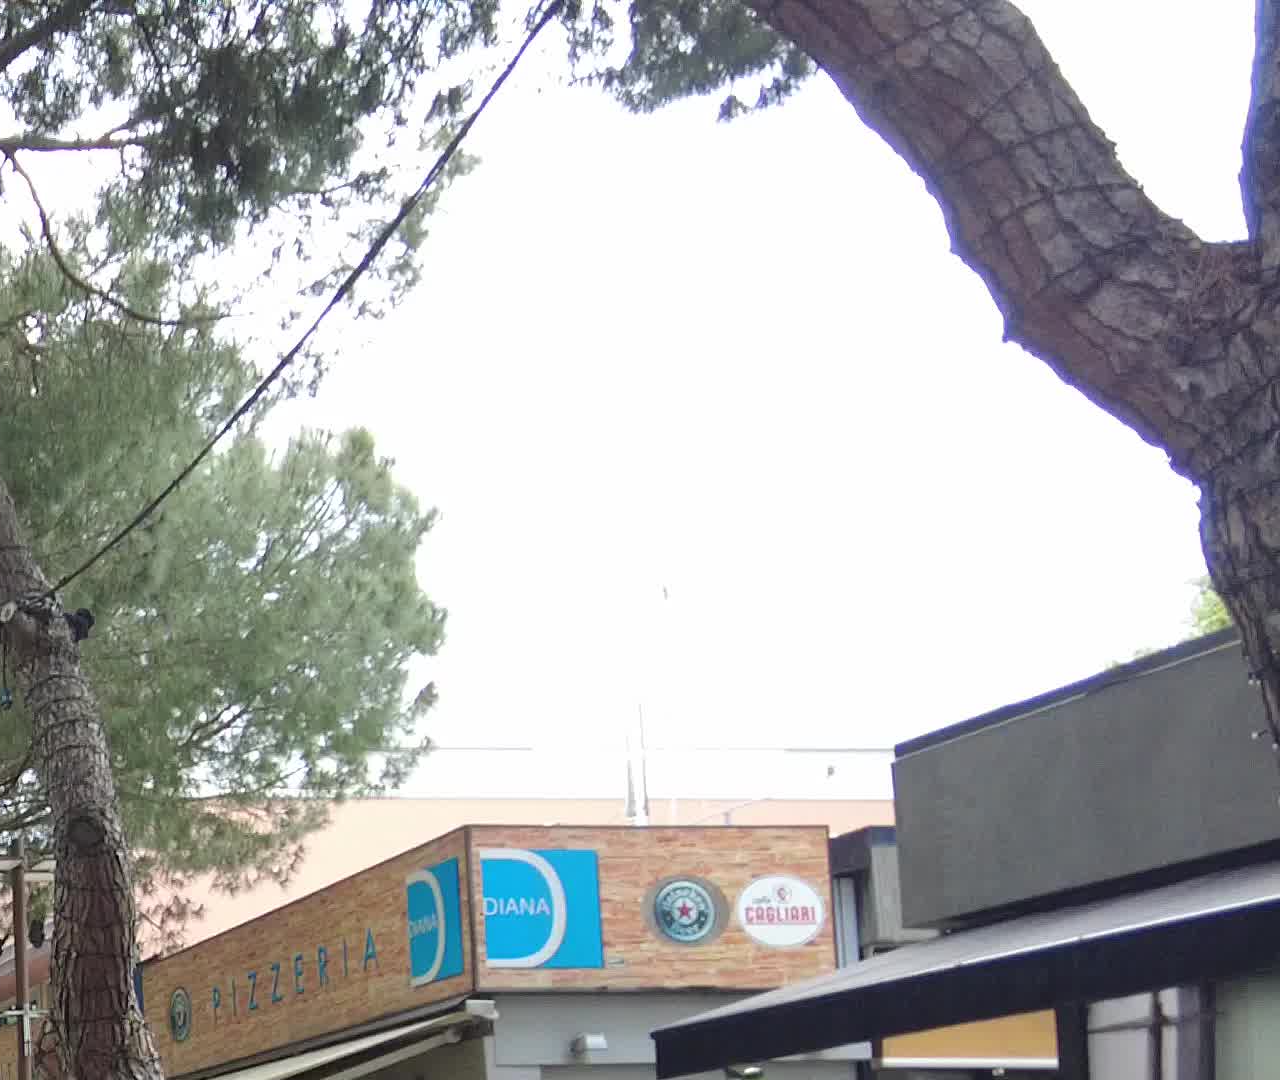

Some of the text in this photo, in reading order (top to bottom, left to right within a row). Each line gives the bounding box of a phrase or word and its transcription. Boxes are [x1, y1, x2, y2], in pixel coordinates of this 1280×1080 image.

[482, 898, 551, 916] DIANA
[744, 906, 816, 923] CAGLIARI
[212, 928, 379, 1023] PIZZERIA
